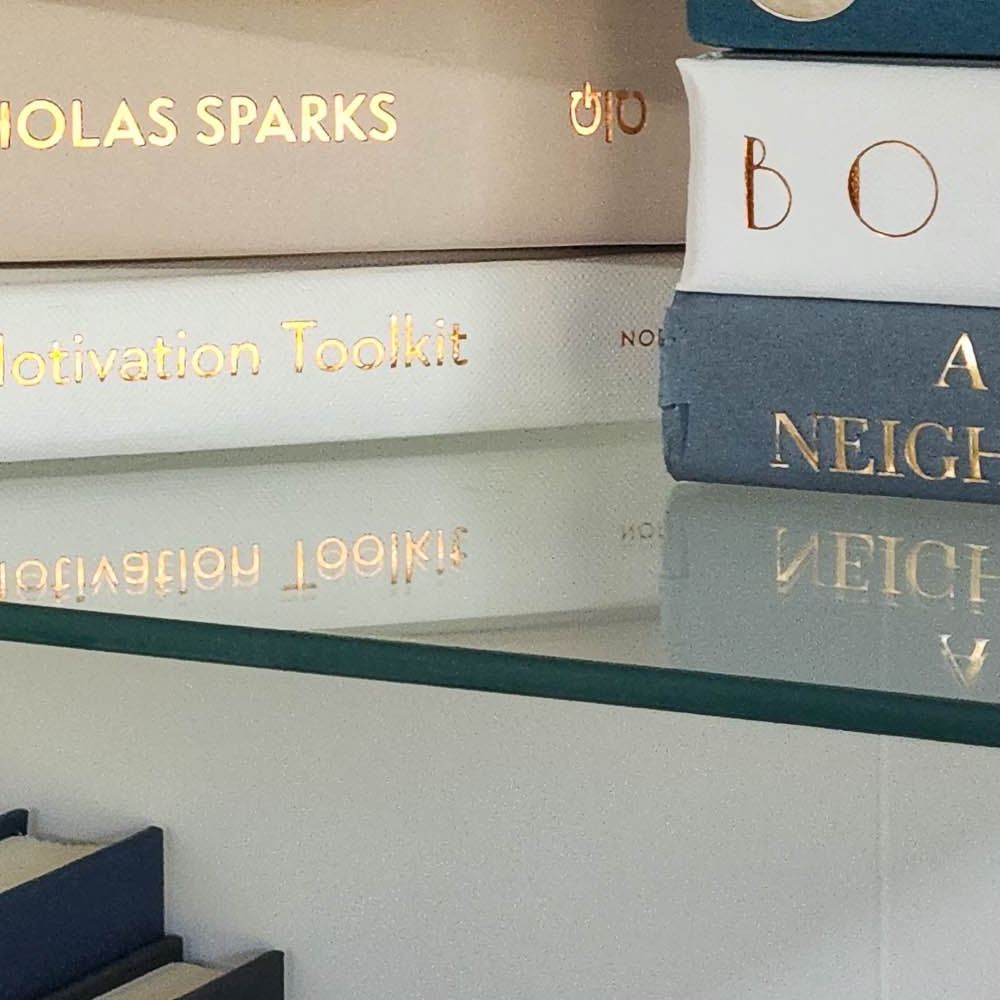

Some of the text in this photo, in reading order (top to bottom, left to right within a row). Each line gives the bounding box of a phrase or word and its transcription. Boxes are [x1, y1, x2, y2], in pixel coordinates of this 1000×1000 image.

[196, 92, 399, 146] SPARKS
[280, 313, 469, 375] Toolkit
[934, 331, 990, 391] A
